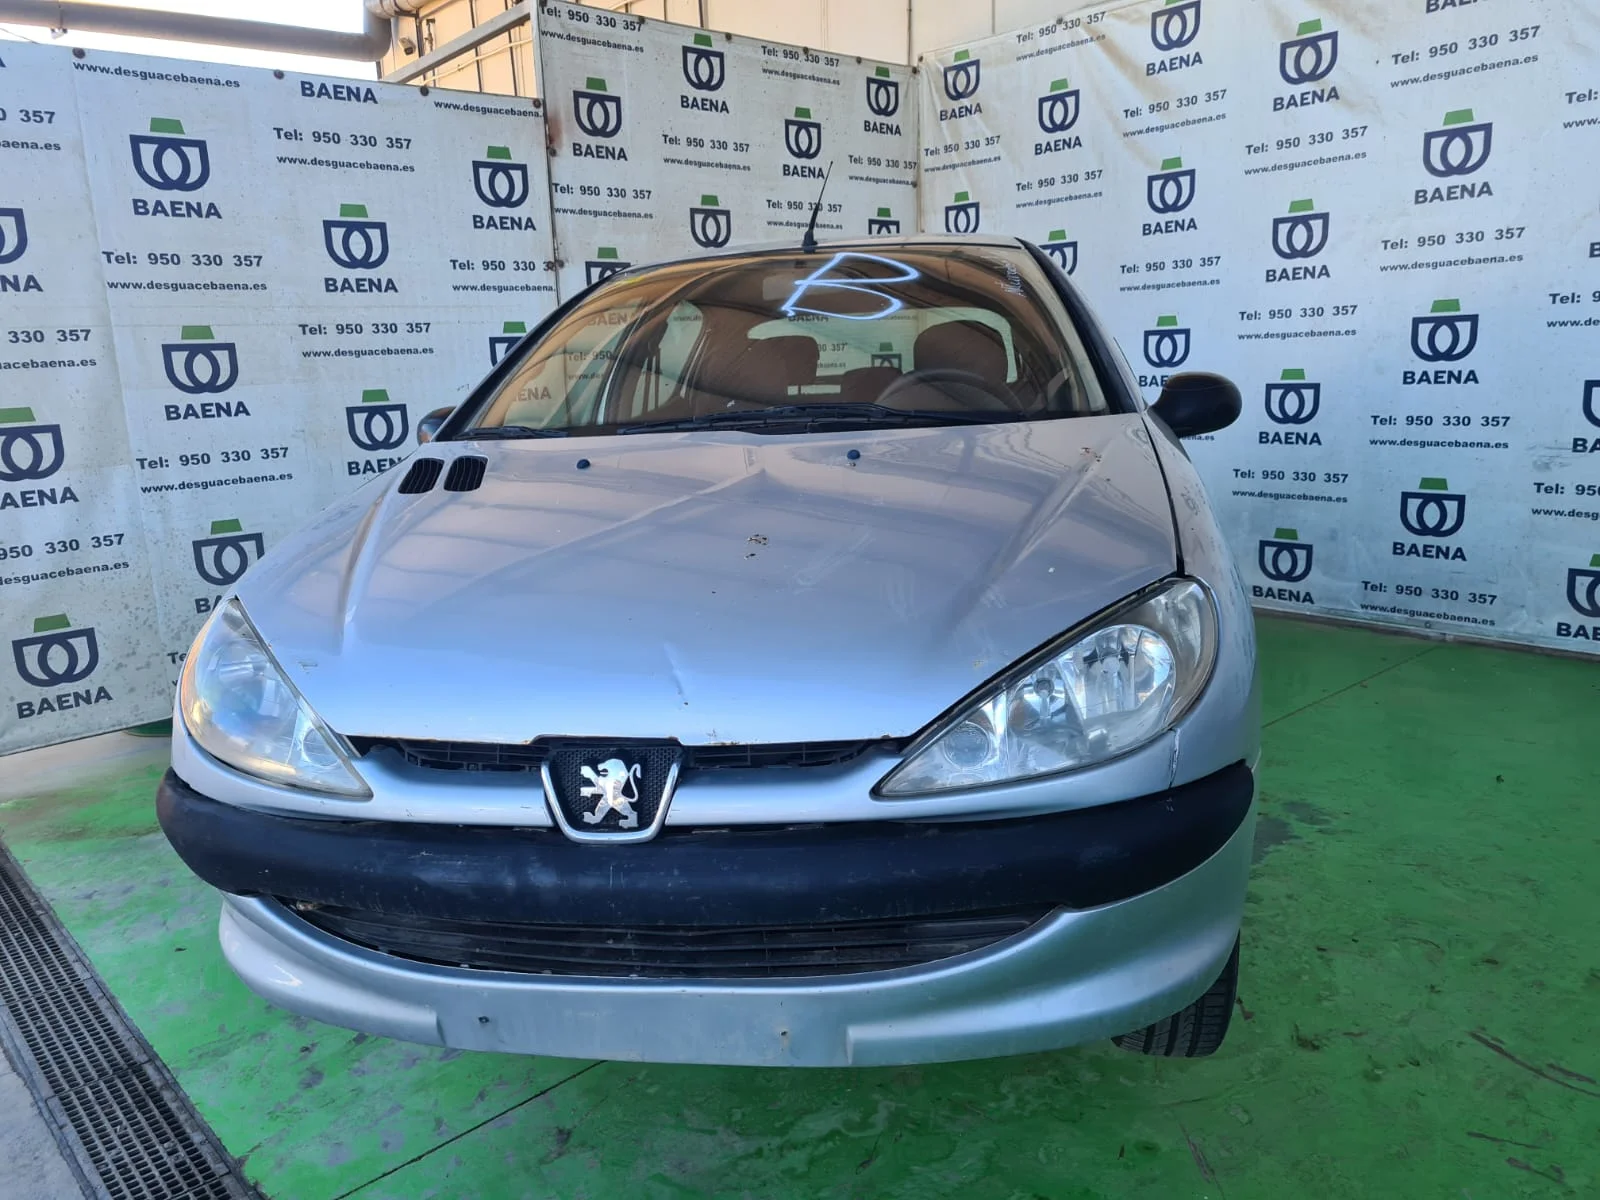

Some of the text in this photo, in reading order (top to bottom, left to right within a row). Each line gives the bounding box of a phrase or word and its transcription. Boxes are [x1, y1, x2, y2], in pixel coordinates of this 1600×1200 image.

[567, 9, 590, 23] 950
[595, 14, 617, 28] 330
[623, 19, 642, 32] 357
[1016, 11, 1107, 44] Tel: 950 330 357
[1391, 25, 1541, 65] Tel: 950 330 357
[760, 45, 840, 67] Tel: 950 330 357
[1146, 51, 1203, 77] BAENA
[73, 62, 240, 88] www.desguacebaena.es
[1390, 54, 1539, 87] www.desguacebaena.es
[300, 80, 378, 104] BAENA
[1273, 86, 1340, 112] BAENA
[1565, 89, 1598, 104] Tel:
[434, 100, 543, 118] www.desguacebaena.
[680, 94, 730, 114] BAENA
[939, 102, 983, 122] BAENA
[1123, 89, 1227, 119] Tel: 950 330 357
[19, 109, 55, 124] 357
[1123, 112, 1226, 138] www.desguacebaena.es
[272, 127, 412, 150] Tel: 950 330 357
[864, 120, 902, 137] BAENA
[661, 133, 750, 153] Tel: 950 330 357
[924, 135, 1000, 157] Tel: 950 330 357
[1034, 135, 1082, 156] BAENA
[1245, 125, 1368, 155] Tel: 950 330 357
[572, 142, 628, 162] BAENA
[848, 154, 917, 169] Tel: 950 330 357
[1244, 149, 1367, 175] www.desguacebaena.es
[276, 156, 415, 172] www.desguacebaena.es
[782, 164, 825, 179] BAENA
[1016, 169, 1103, 192] Tel: 950 330 357
[553, 183, 652, 200] Tel: 950 330 357
[1414, 181, 1493, 205] BAENA
[132, 198, 223, 219] BAENA
[766, 199, 842, 213] Tel: 950 357
[472, 214, 537, 231] BAENA
[1142, 217, 1198, 237] BAENA
[1381, 226, 1526, 250] Tel: 950 330 357
[101, 251, 263, 267] Tel: 950 330 357
[449, 259, 475, 271] Tel:
[481, 260, 506, 271] 950
[513, 260, 536, 272] 330
[1120, 256, 1221, 274] Tel: 950 330 357
[1380, 255, 1523, 272] www.desguacebaena.es
[1265, 264, 1331, 283] BAENA
[107, 280, 267, 292] www.desguacebaena.es
[324, 277, 399, 293] BAENA
[452, 283, 554, 294] www.desguacebaena.
[1120, 279, 1220, 292] www.desguacebaena.es
[1548, 292, 1581, 305] Tel:
[1238, 304, 1358, 321] Tel: 950 330 357
[8, 329, 91, 344] 330 357
[298, 322, 431, 335] Tel: 950 330 357
[1237, 329, 1357, 340] www.desguacebaena.es
[302, 347, 434, 358] www.desguacebaena.es
[1138, 375, 1169, 388] BAE
[1402, 369, 1479, 385] BAENA
[164, 401, 251, 421] BAENA
[1370, 415, 1511, 427] Tel: 950 330 357
[1258, 431, 1322, 446] BAENA
[1369, 438, 1509, 449] www.desguacebaena.es
[135, 447, 289, 470] Tel: 950 330 357
[347, 457, 401, 476] BAE
[140, 473, 293, 494] www.desguacebaena.es
[1232, 468, 1349, 484] Tel: 950 330 357
[0, 486, 80, 510] AENA
[1232, 489, 1348, 503] www.desguacebaena.es
[1533, 482, 1600, 496] Tel: 95
[44, 539, 80, 554] 330
[91, 533, 125, 549] 357
[1392, 541, 1468, 562] BAENA
[0, 561, 130, 586] esguacebaena.es
[1252, 585, 1315, 605] BAENA
[1361, 580, 1498, 606] Tel: 950 330 357
[1360, 603, 1495, 625] www.desguacebaena.es
[1556, 621, 1600, 642] BAE
[16, 686, 114, 719] BAENA
